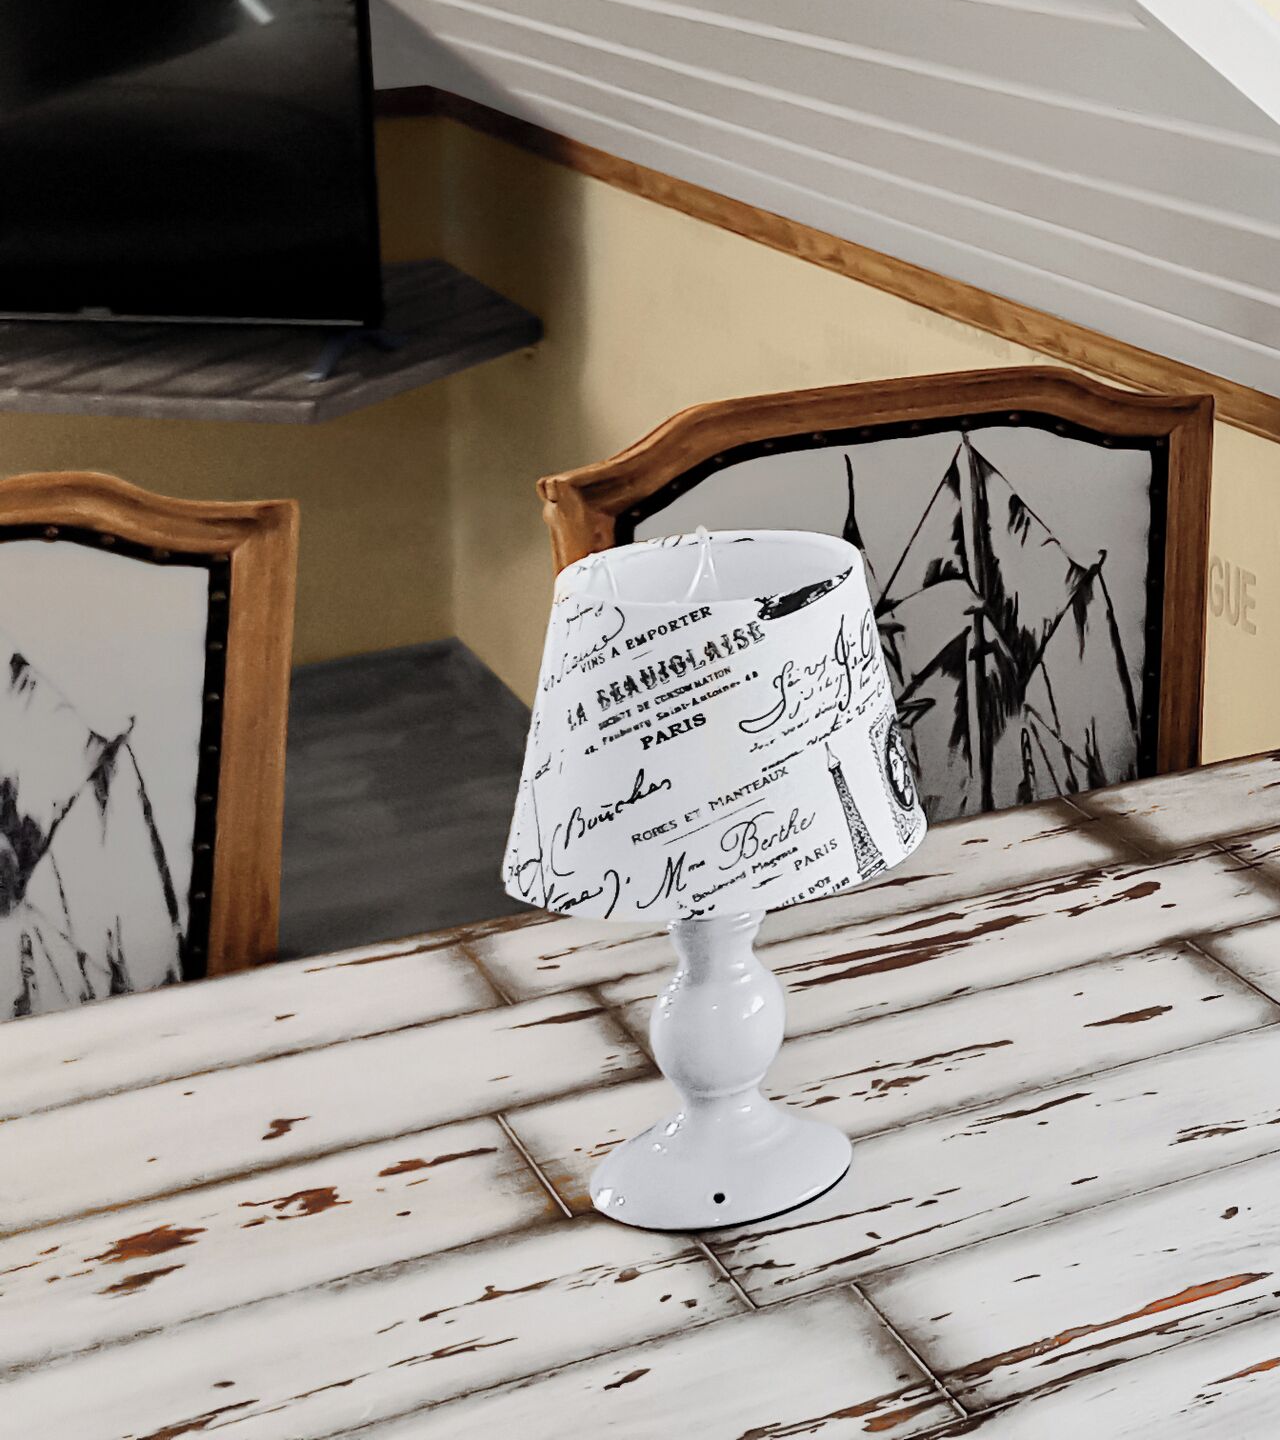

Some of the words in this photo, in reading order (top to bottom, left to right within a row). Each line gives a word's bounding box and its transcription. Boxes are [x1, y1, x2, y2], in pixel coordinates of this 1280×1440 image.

[625, 606, 712, 650] EMPORTER
[640, 713, 707, 750] PARIS
[709, 766, 789, 811] MANTEAUX
[719, 808, 816, 870] Berthe
[794, 838, 838, 871] PARIS
